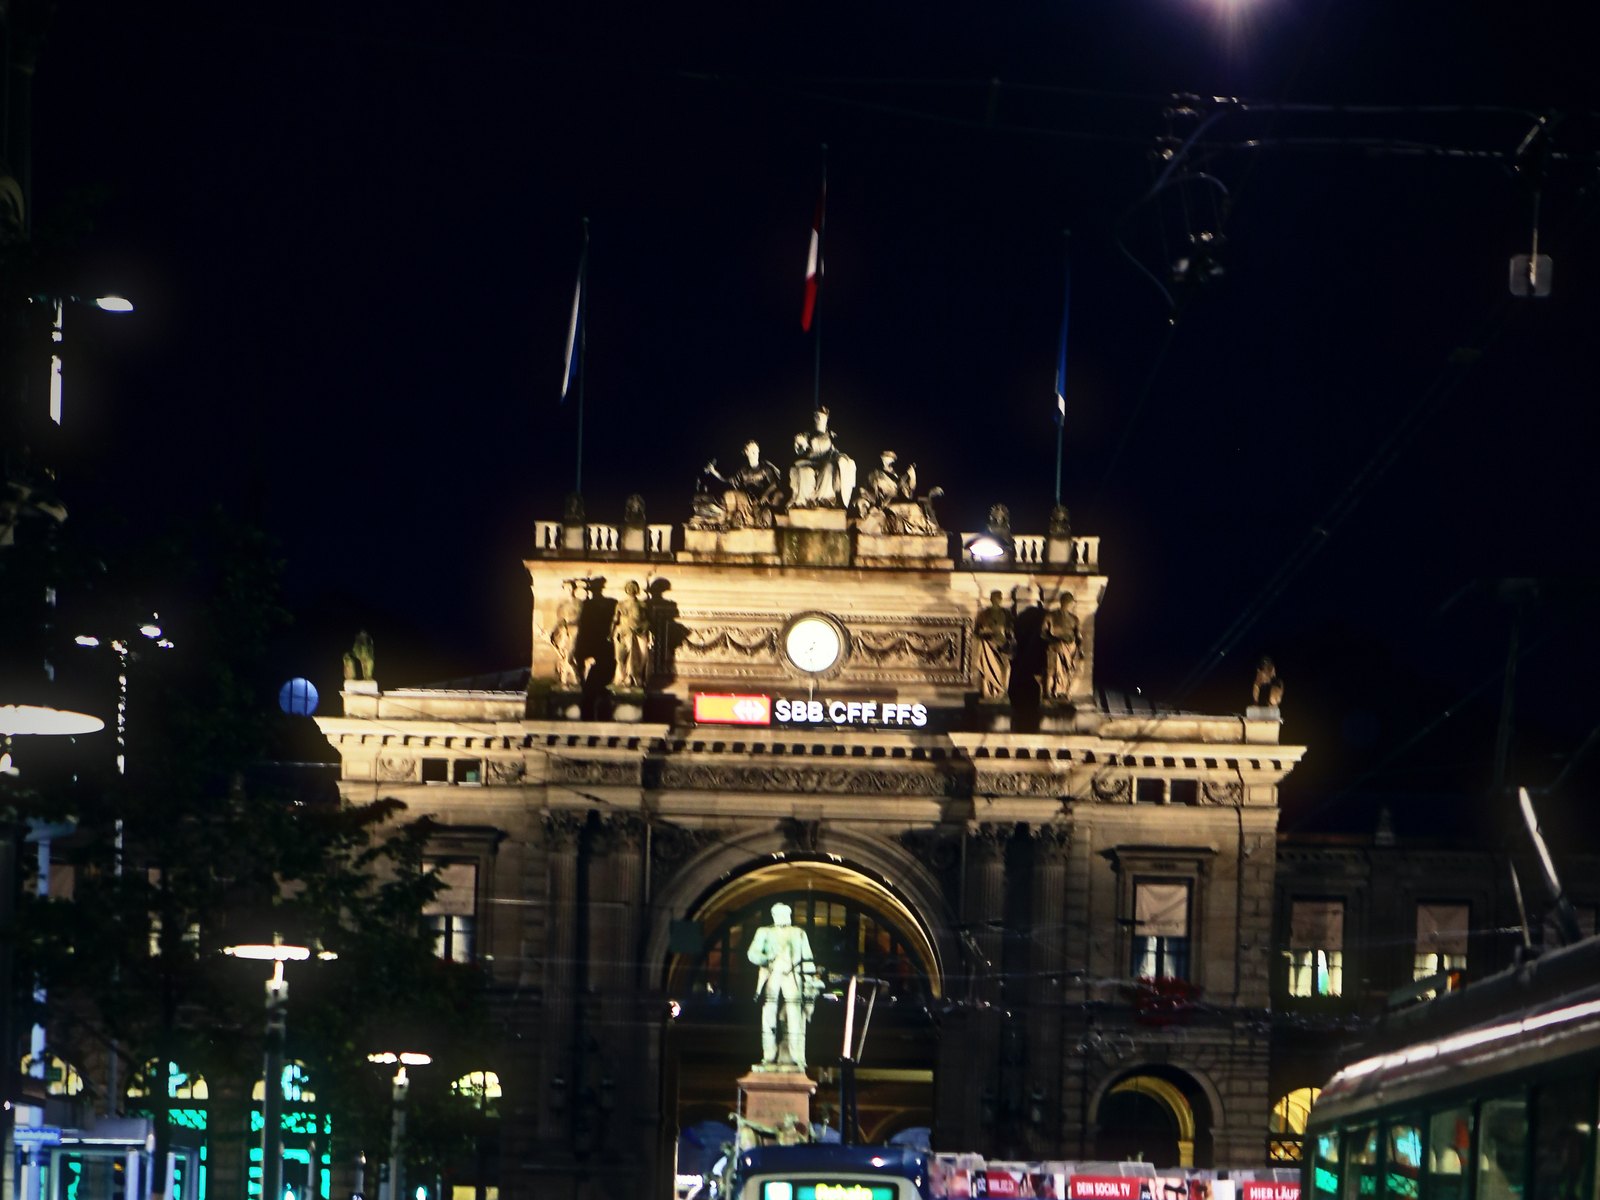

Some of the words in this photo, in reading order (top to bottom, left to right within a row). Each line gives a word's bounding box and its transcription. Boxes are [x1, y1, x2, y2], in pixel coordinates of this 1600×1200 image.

[774, 700, 824, 723] SBB
[828, 701, 877, 725] CFF
[881, 703, 928, 727] FFS
[1076, 1181, 1095, 1196] DEIN
[1094, 1182, 1121, 1197] SOCIAL
[1121, 1183, 1131, 1197] TV
[1250, 1186, 1274, 1200] HIER
